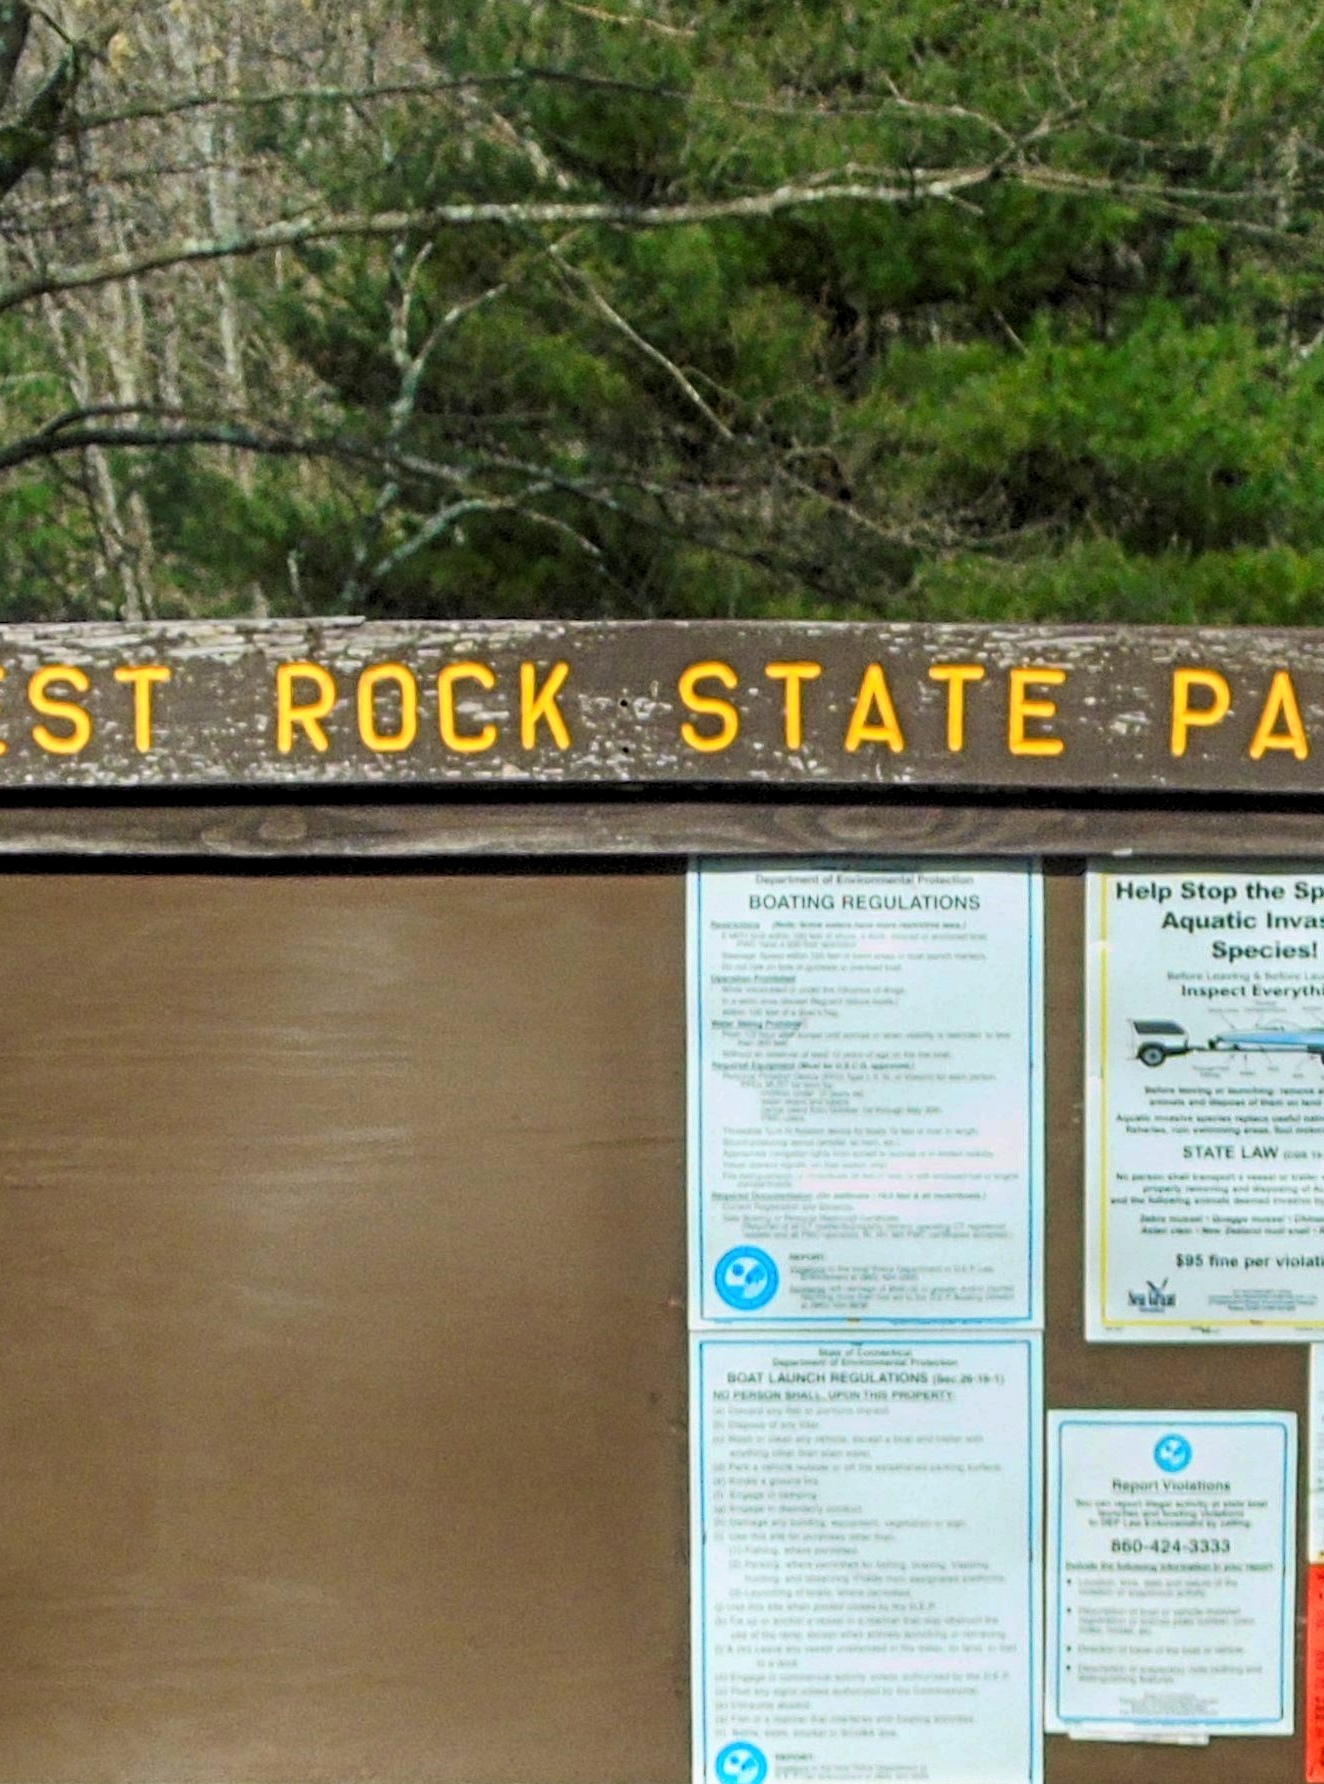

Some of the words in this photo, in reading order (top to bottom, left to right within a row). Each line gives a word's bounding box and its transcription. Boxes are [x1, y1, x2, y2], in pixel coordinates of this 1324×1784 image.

[278, 661, 572, 752] ROCK
[678, 661, 1066, 757] STATE
[755, 875, 818, 886] Department
[822, 875, 833, 884] of
[836, 875, 913, 884] Environmental
[917, 875, 973, 884] Protection
[1116, 882, 1171, 903] Help
[1181, 882, 1237, 903] Stop
[1246, 882, 1285, 899] the
[749, 895, 834, 910] BOATING
[842, 895, 980, 909] REGULATIONS
[1162, 911, 1256, 933] Aquatic
[1212, 940, 1317, 962] Species!
[1167, 971, 1203, 980] Before
[1206, 971, 1250, 982] Leaving
[1254, 972, 1261, 980] &
[1265, 971, 1301, 980] Before
[1181, 985, 1246, 999] Inspect
[1183, 1146, 1234, 1159] STATE
[1241, 1146, 1279, 1159] LAW
[1176, 1253, 1204, 1268] $95
[1209, 1254, 1238, 1267] fine
[1244, 1256, 1269, 1270] per
[727, 1372, 763, 1384] BOAT
[769, 1372, 825, 1384] LAUNCH
[830, 1372, 928, 1384] REGULATIONS
[713, 1391, 729, 1400] NO
[733, 1391, 781, 1400] PERSON
[828, 1391, 859, 1400] UPON
[863, 1391, 888, 1400] THIS
[1112, 1480, 1158, 1493] Report
[1163, 1480, 1230, 1491] Violations
[1111, 1539, 1230, 1553] 860-424-3333
